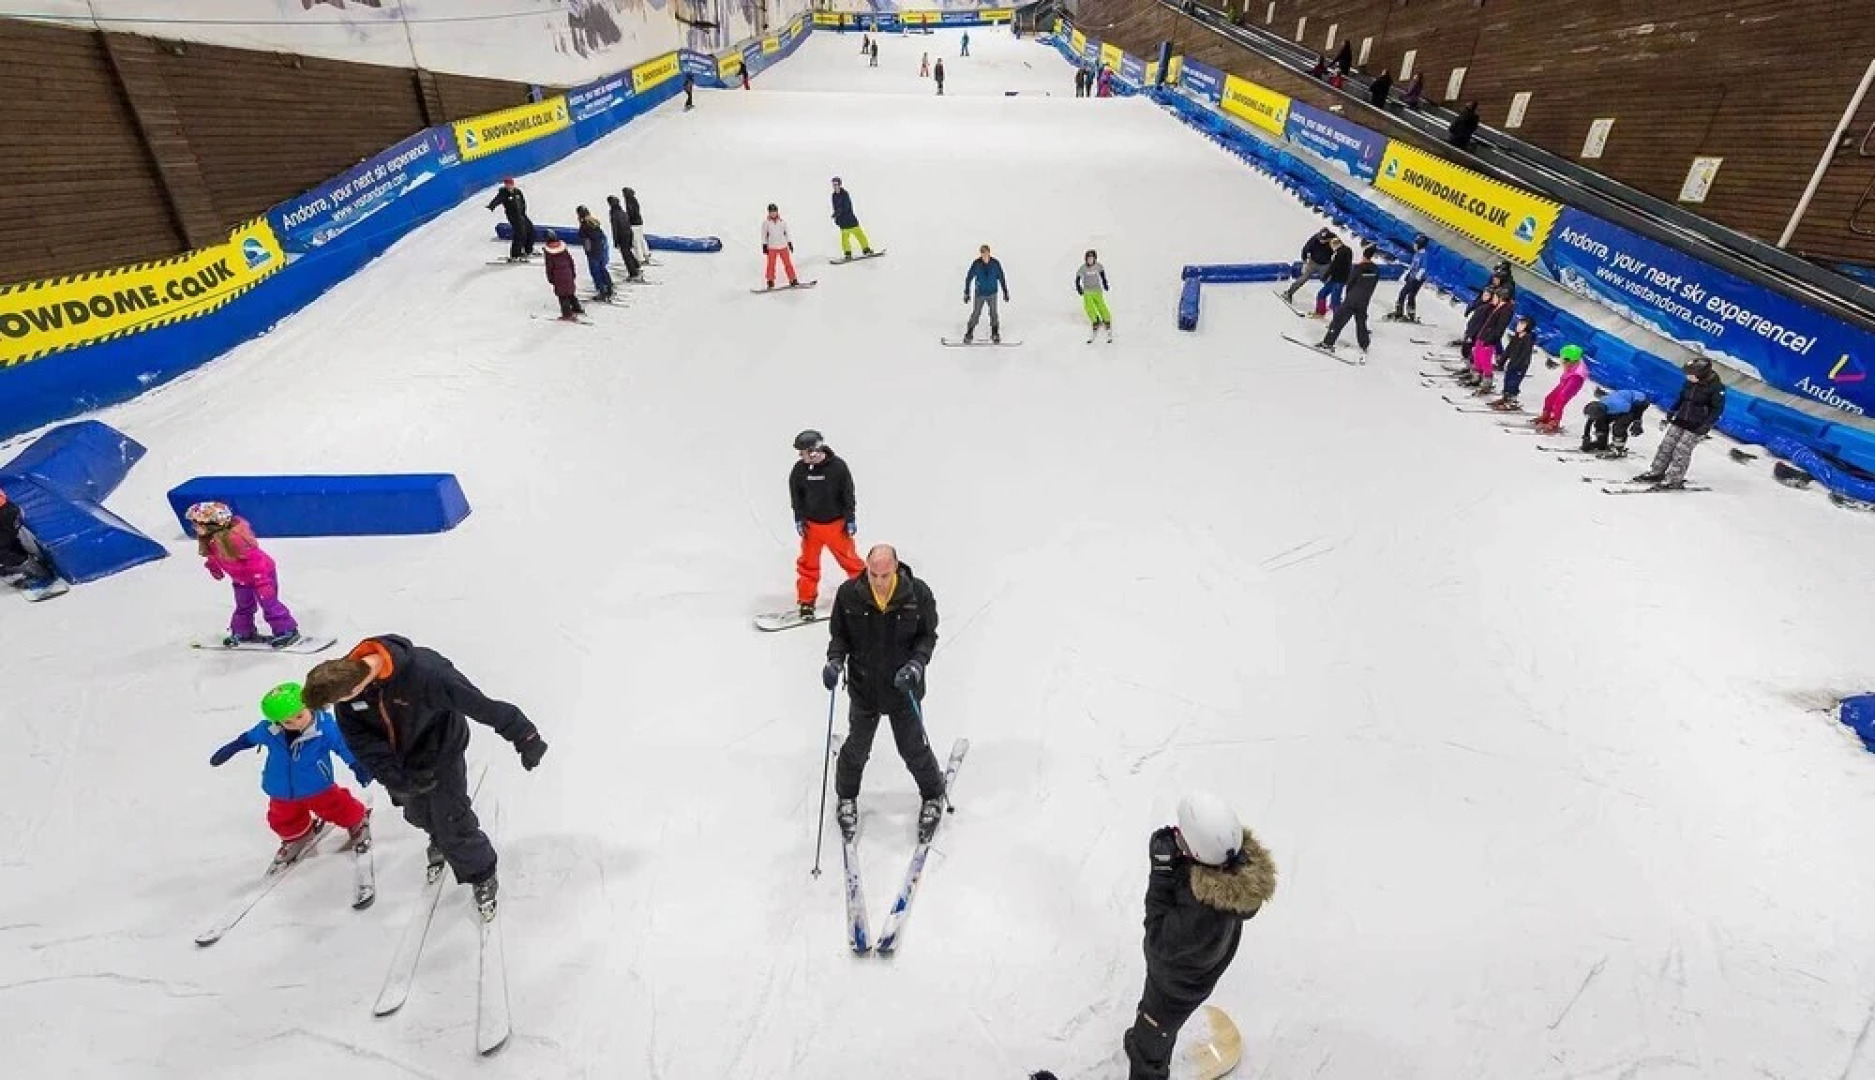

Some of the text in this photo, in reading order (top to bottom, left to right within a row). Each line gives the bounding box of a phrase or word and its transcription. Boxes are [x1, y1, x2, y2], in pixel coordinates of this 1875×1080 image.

[283, 198, 331, 231] Andorra,
[1402, 168, 1511, 228] SNOWDOME.CO.UK
[0, 258, 235, 338] OWDOME.CO.UK
[1558, 226, 1818, 355] Andorra, your next ski experience!
[1596, 265, 1724, 337] www.visitandorra.com
